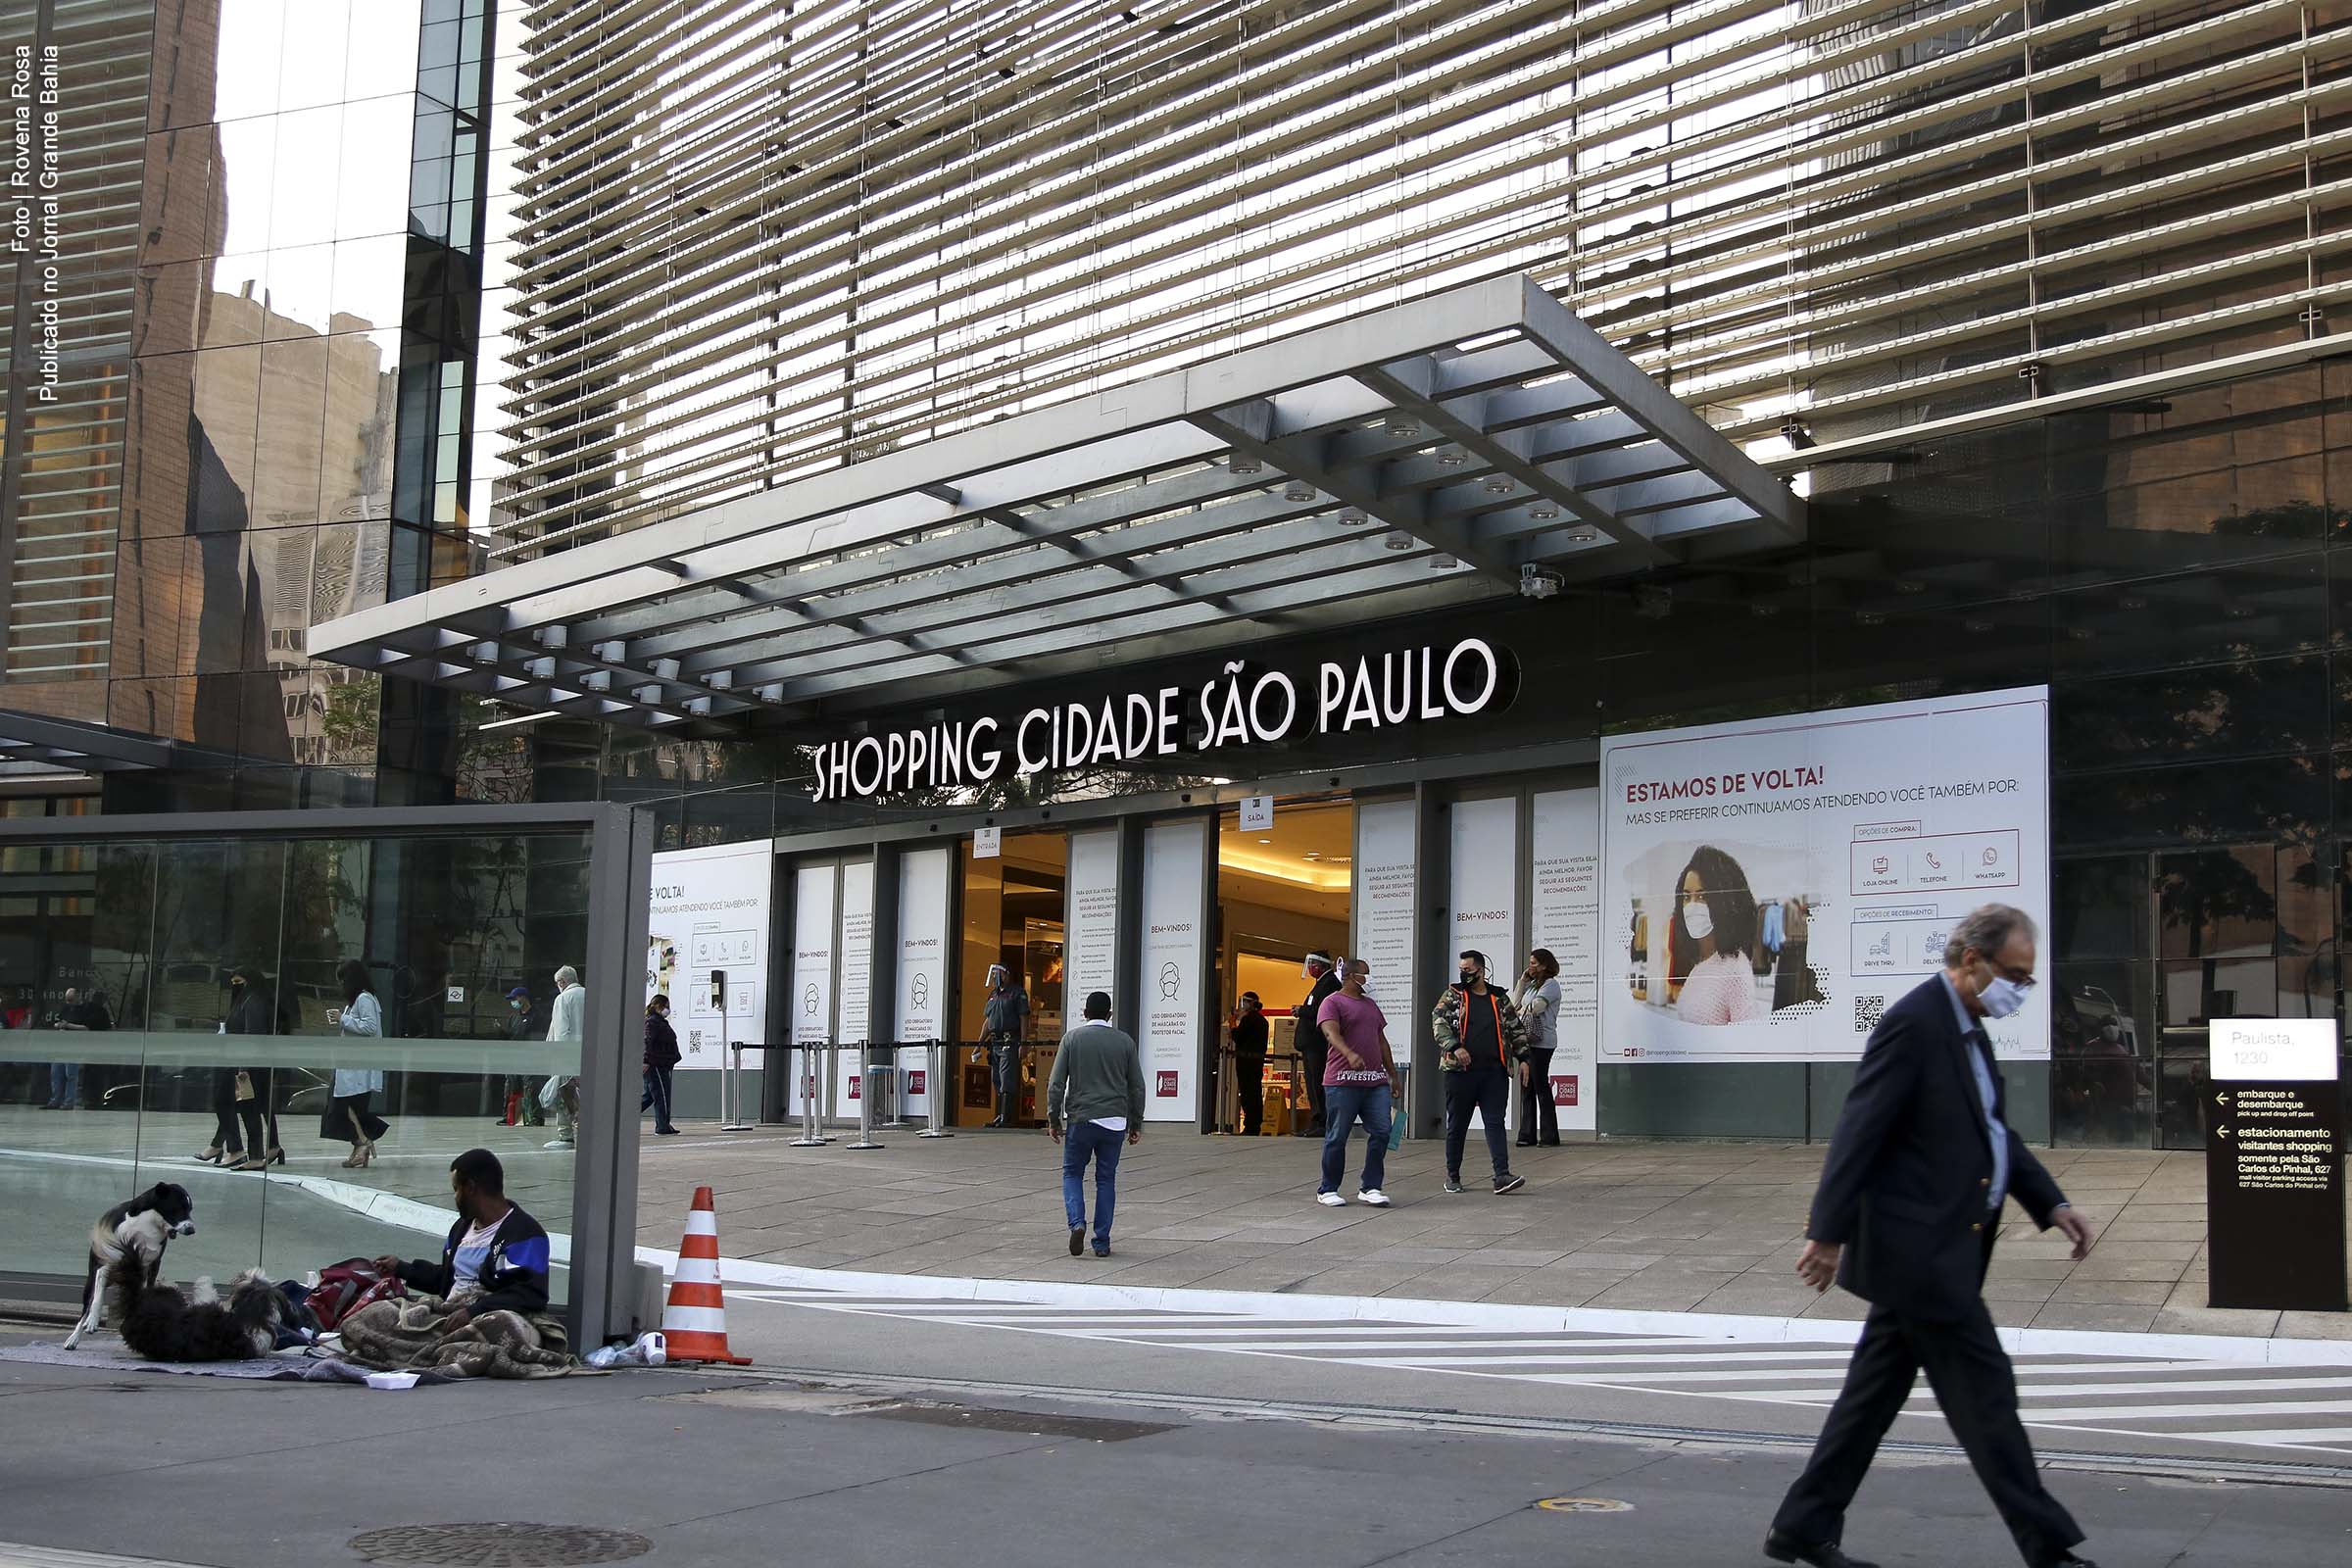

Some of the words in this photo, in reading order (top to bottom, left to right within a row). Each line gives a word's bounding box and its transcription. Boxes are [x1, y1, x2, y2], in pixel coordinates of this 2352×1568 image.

[812, 716, 1003, 804] SHOPPING
[1016, 687, 1180, 774] CIDADE
[1198, 660, 1297, 751] SÃO
[1319, 638, 1497, 734] PAULO
[1626, 776, 1717, 804] ESTAMOS
[1722, 773, 1746, 795] DE
[1751, 765, 1824, 791] VOLTA!
[1626, 810, 1651, 825] MAS
[1654, 810, 1668, 823] SE
[1669, 807, 1719, 821] PREFERIR
[1722, 798, 1810, 816] CONTINUAMOS
[1813, 791, 1886, 809] ATENDENDO
[1890, 785, 1925, 804] VOCÊ
[1928, 781, 1984, 801] TAMBÉM
[1988, 779, 2019, 795] POR:
[1248, 812, 1264, 822] SAÍDA
[1890, 825, 1917, 834] COMPRA:
[1920, 875, 1947, 884] TELEFONE
[1975, 871, 2005, 880] WHATSAPP
[656, 886, 685, 900] VOLTA!
[1457, 910, 1508, 922] BEM-VINDOS!
[1152, 923, 1193, 934] BEM-VINDOS!
[2231, 1031, 2295, 1047] Paulista,
[2233, 1052, 2269, 1064] 1230
[2237, 1090, 2286, 1100] embarque
[2237, 1100, 2304, 1109] desembarque
[2238, 1127, 2330, 1138] estacionamento
[2238, 1141, 2284, 1151] visitantes
[2286, 1141, 2331, 1152] shopping
[2238, 1154, 2278, 1163] somente
[2279, 1154, 2299, 1164] pela
[2302, 1154, 2320, 1163] São
[2238, 1164, 2267, 1173] Carlos
[2269, 1164, 2281, 1173] do
[2283, 1164, 2313, 1175] Pinhal,
[2315, 1165, 2331, 1174] 627
